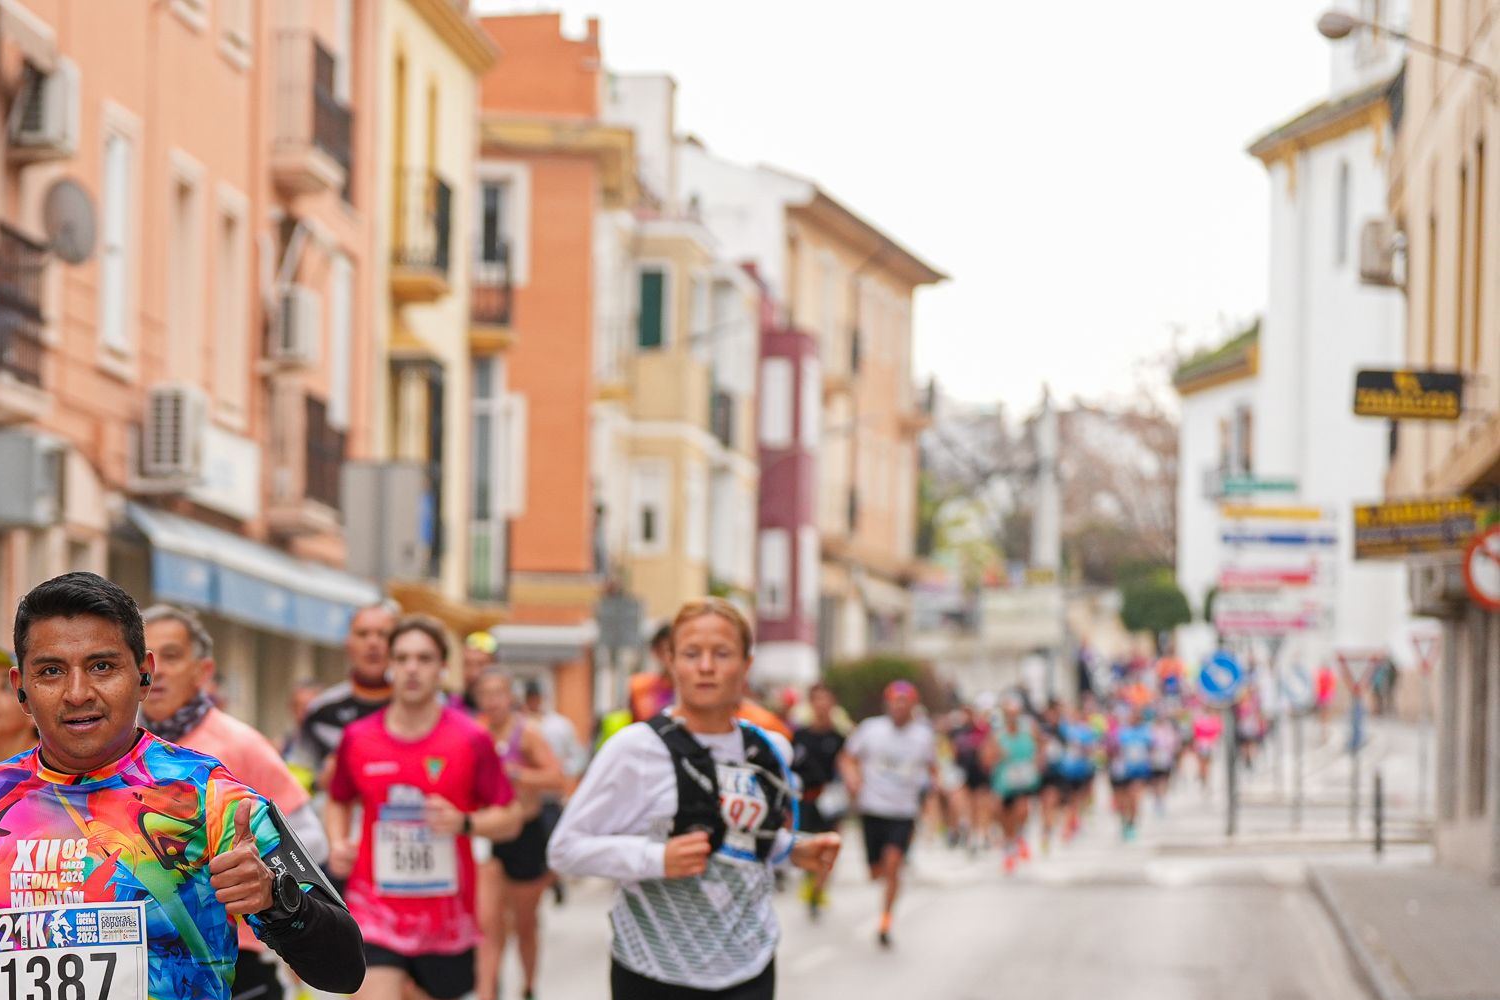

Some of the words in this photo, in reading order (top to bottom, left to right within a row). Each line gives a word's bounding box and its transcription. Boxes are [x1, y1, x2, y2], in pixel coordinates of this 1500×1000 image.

[12, 839, 61, 872] XII
[61, 838, 88, 859] 08
[60, 861, 85, 869] MARZO
[10, 872, 59, 890] MEDIA
[60, 871, 84, 883] 2026
[10, 887, 85, 908] MARATÓN
[76, 917, 97, 926] LUCENA
[101, 920, 137, 929] populares
[0, 913, 47, 949] 21K
[77, 931, 98, 943] 2026
